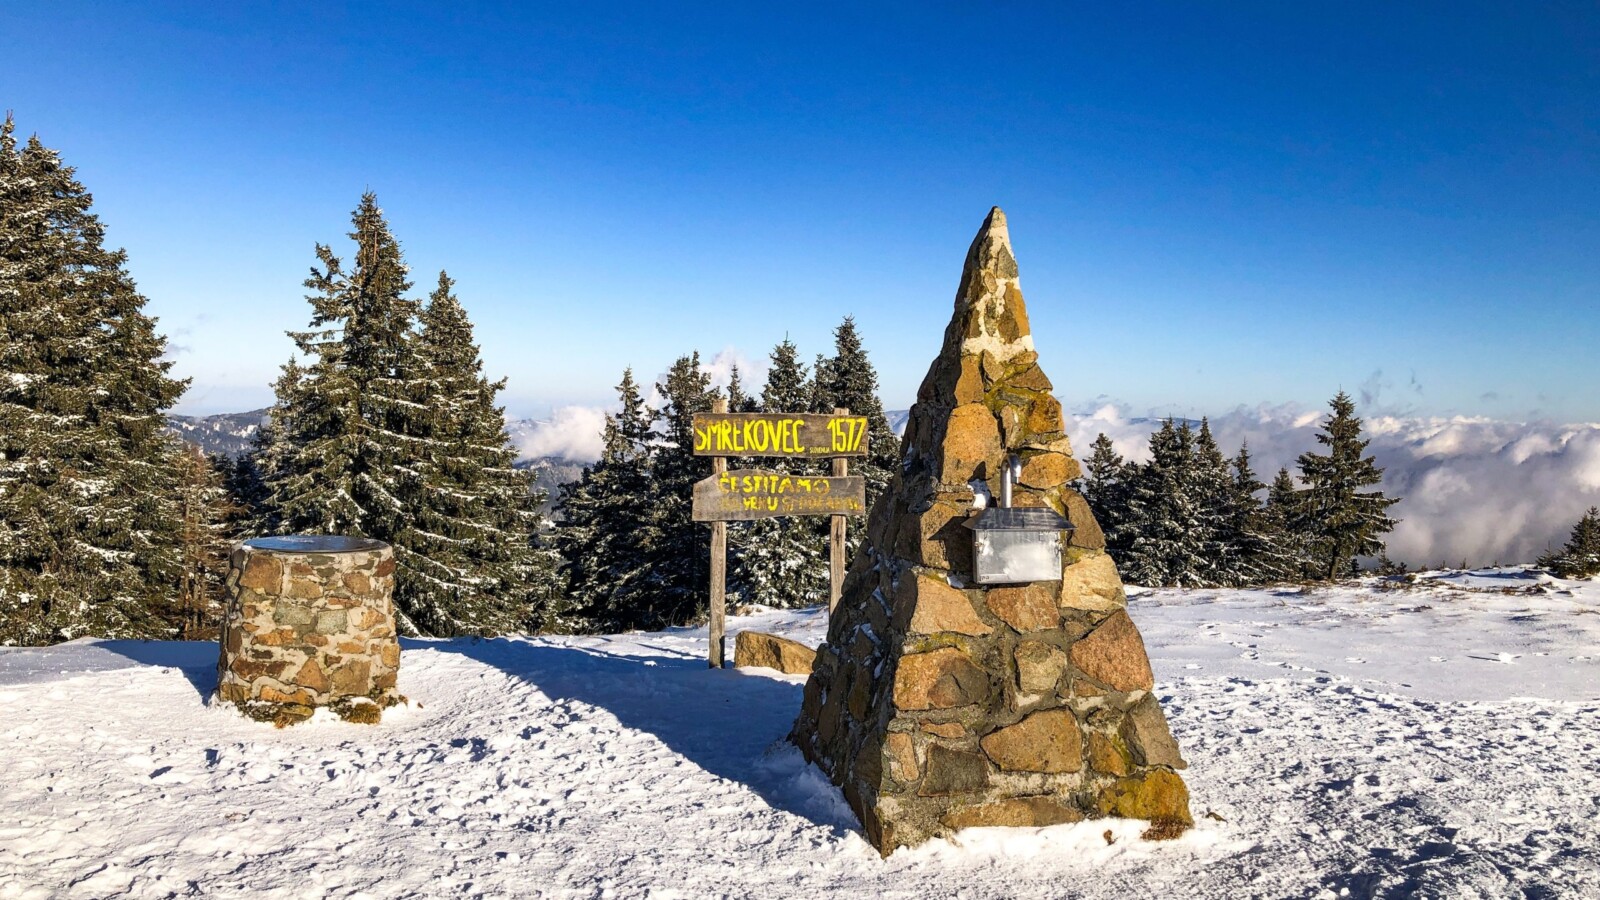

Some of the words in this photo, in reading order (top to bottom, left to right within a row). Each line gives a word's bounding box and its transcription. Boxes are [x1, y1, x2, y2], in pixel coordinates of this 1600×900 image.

[694, 418, 806, 453] SMREKOVEC
[827, 417, 868, 453] 1577
[719, 471, 831, 495] ČESTITAMO
